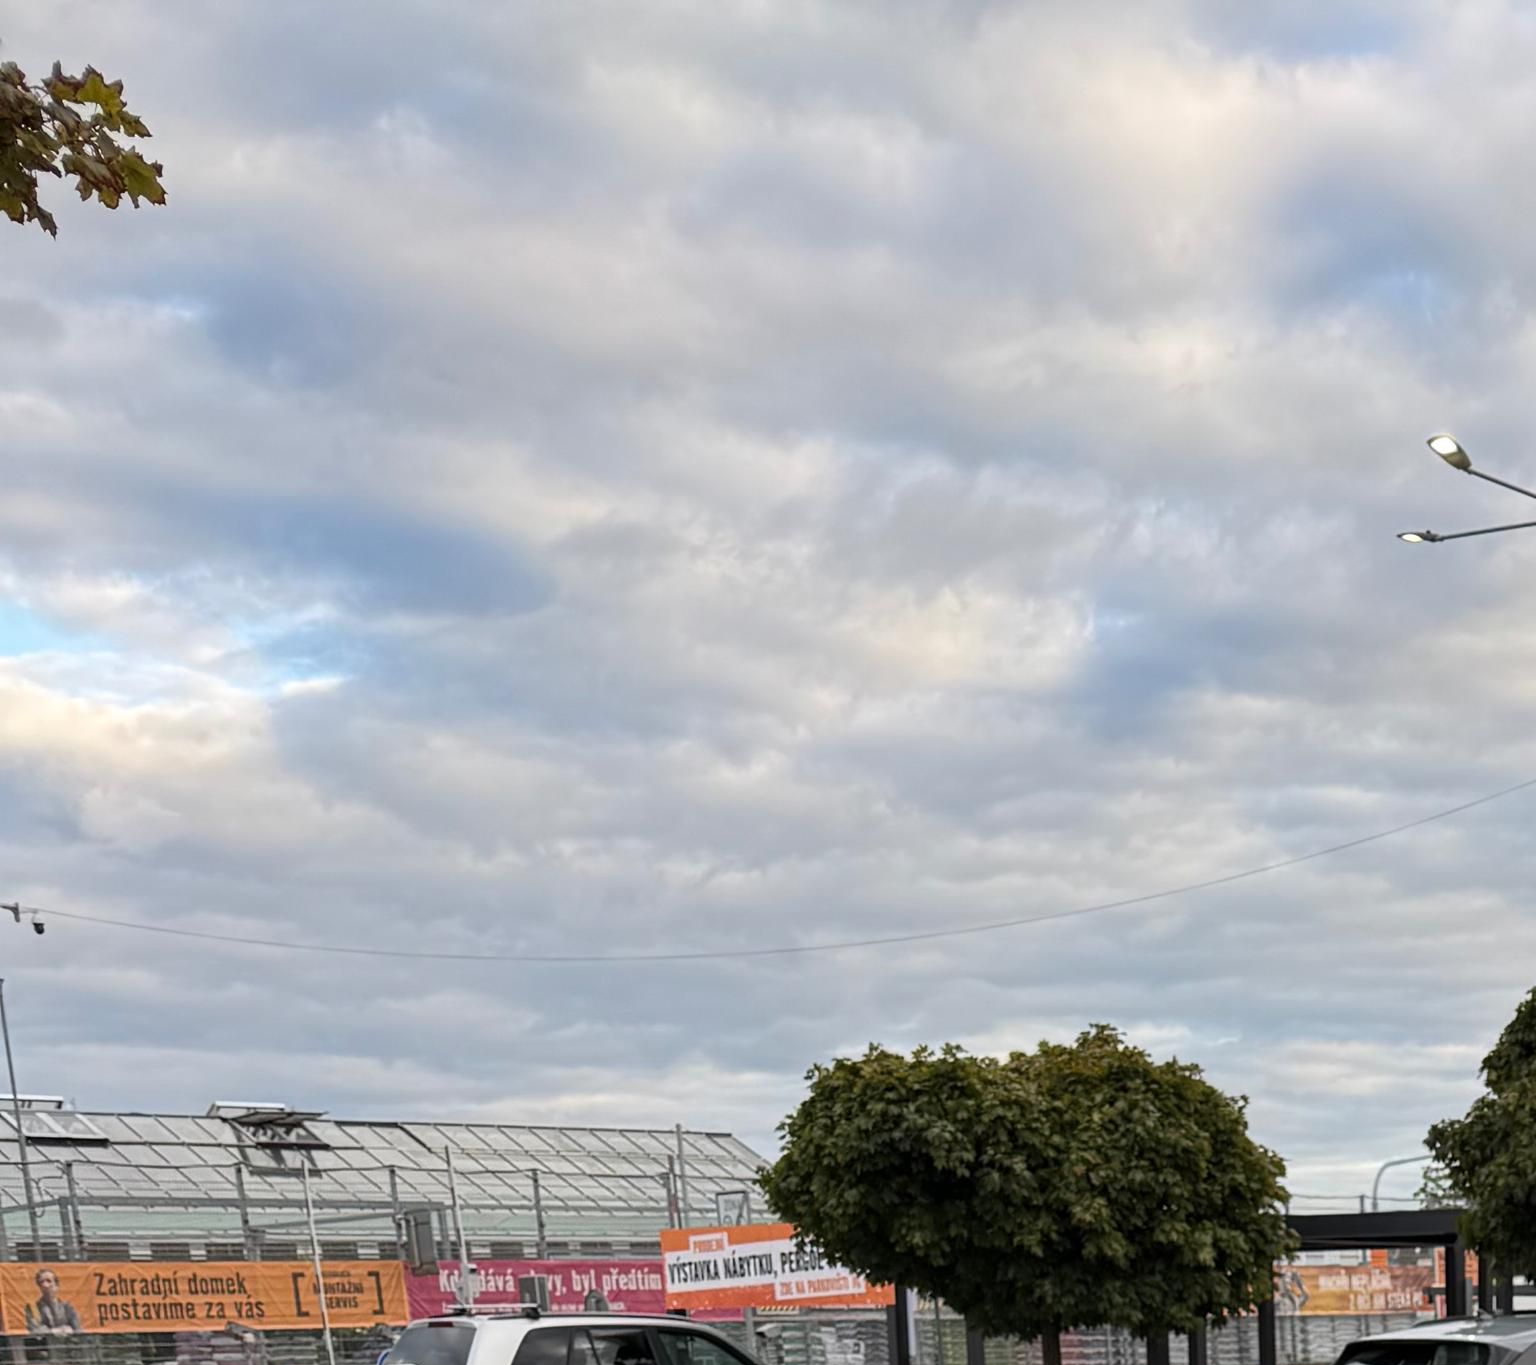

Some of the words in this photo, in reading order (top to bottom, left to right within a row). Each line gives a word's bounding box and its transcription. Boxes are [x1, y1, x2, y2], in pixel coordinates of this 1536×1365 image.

[93, 1270, 180, 1296] Zahradní
[187, 1271, 248, 1296] domek
[571, 1268, 597, 1296] byl
[602, 1267, 663, 1296] předtím
[668, 1257, 721, 1285] VÝSTAVKA
[97, 1296, 196, 1325] postavíme
[204, 1301, 226, 1320] za
[234, 1294, 265, 1319] vás
